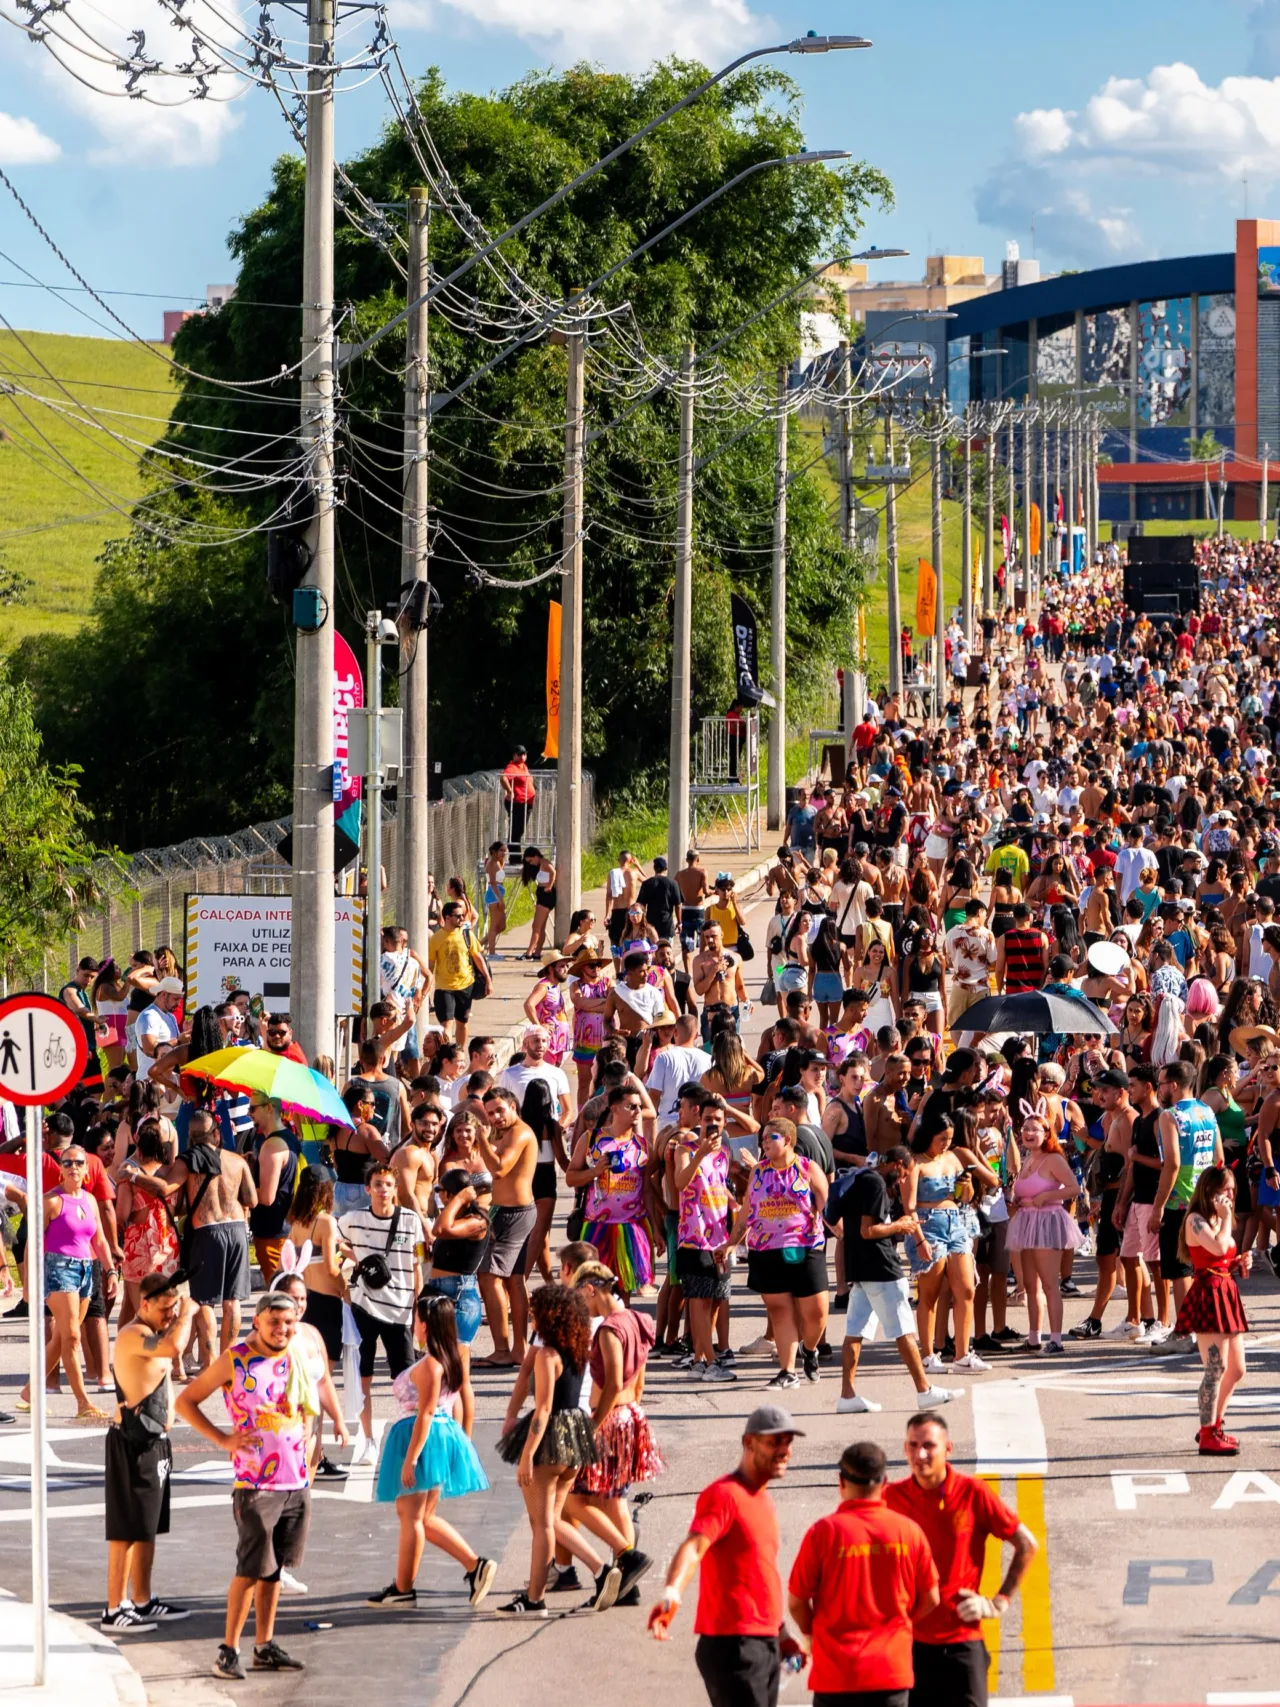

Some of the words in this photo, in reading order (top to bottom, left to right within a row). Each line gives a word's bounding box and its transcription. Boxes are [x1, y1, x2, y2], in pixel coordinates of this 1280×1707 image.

[200, 909, 262, 922] CALÇADA
[252, 929, 291, 939] UTILIZ
[214, 943, 248, 953] FAIXA
[252, 943, 268, 953] DE
[223, 957, 254, 967] PARA
[258, 958, 266, 967] A
